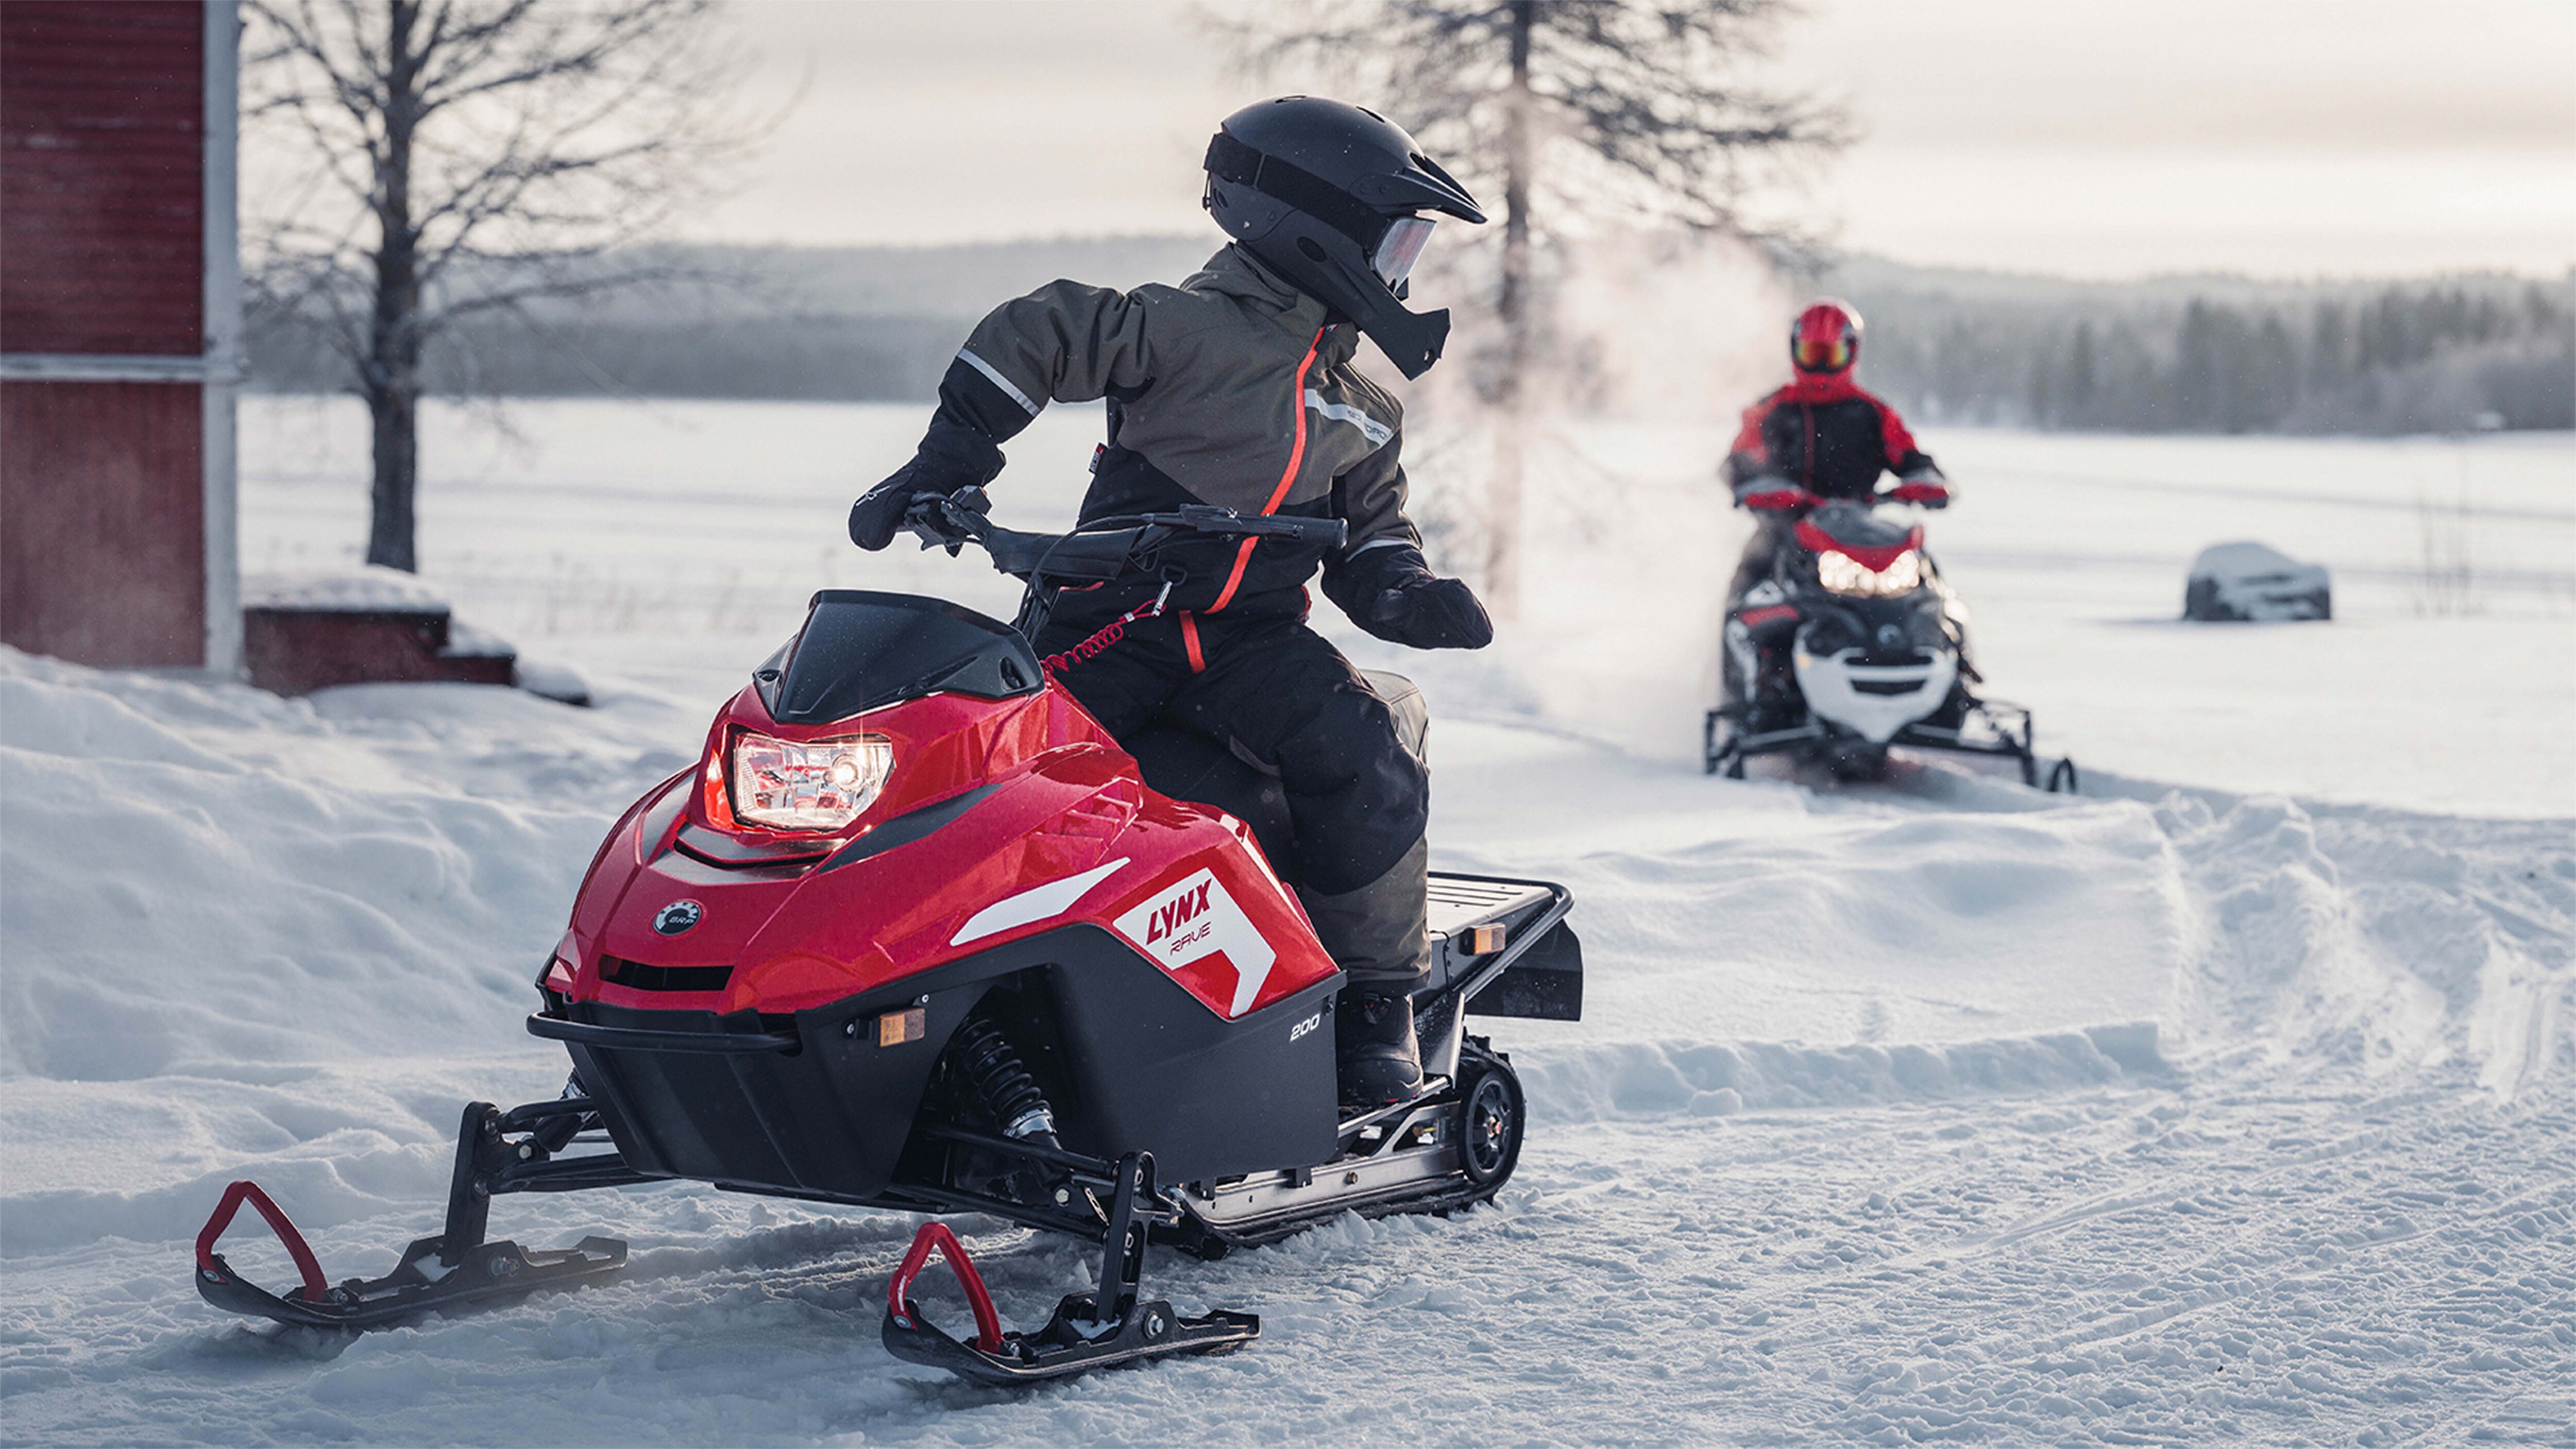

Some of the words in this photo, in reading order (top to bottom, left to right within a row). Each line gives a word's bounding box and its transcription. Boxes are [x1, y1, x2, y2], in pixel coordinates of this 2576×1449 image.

[669, 915, 694, 925] BRP
[1146, 878, 1212, 946] LYNX
[1170, 921, 1211, 956] RAVE
[1290, 1013, 1320, 1042] 200
